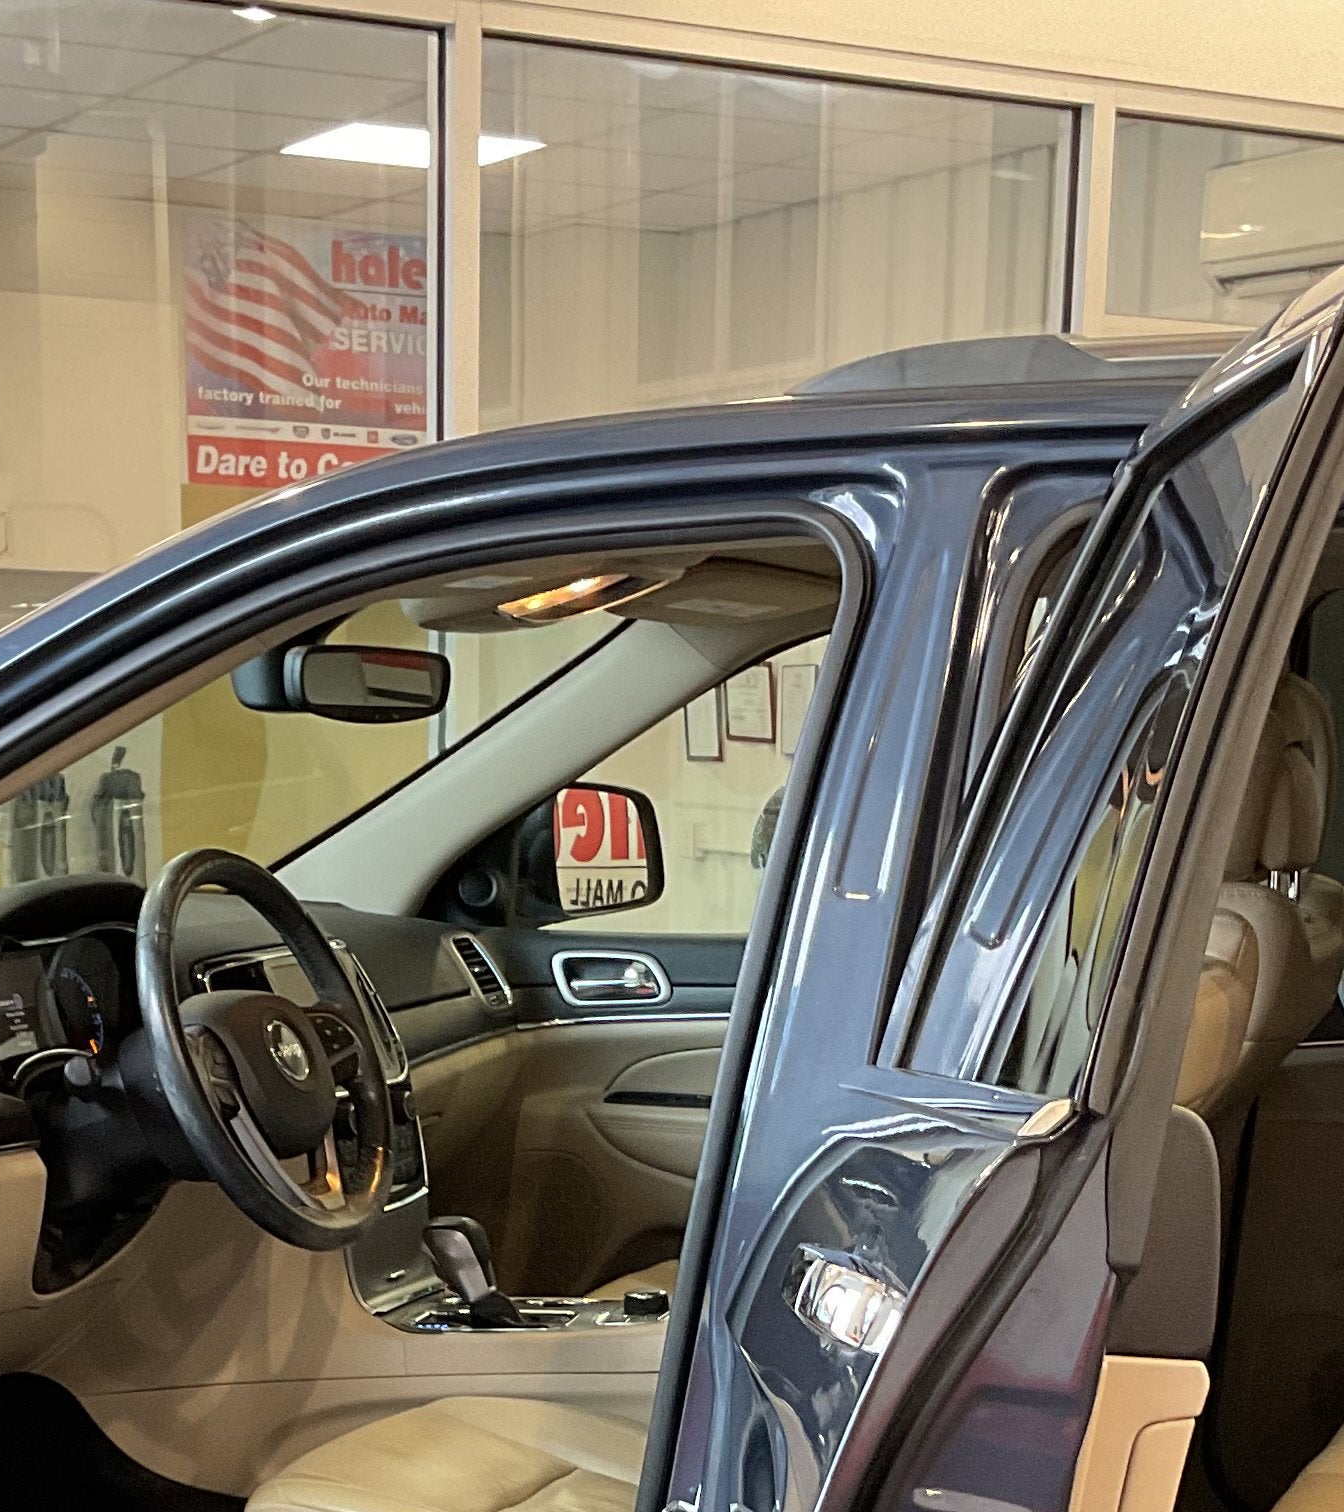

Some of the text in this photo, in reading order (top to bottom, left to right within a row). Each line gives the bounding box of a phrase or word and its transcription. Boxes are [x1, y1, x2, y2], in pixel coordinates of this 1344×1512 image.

[302, 374, 424, 396] Our technicians
[198, 386, 254, 405] factory
[259, 391, 315, 409] trained
[320, 395, 343, 412] for
[196, 445, 358, 480] Dare to C
